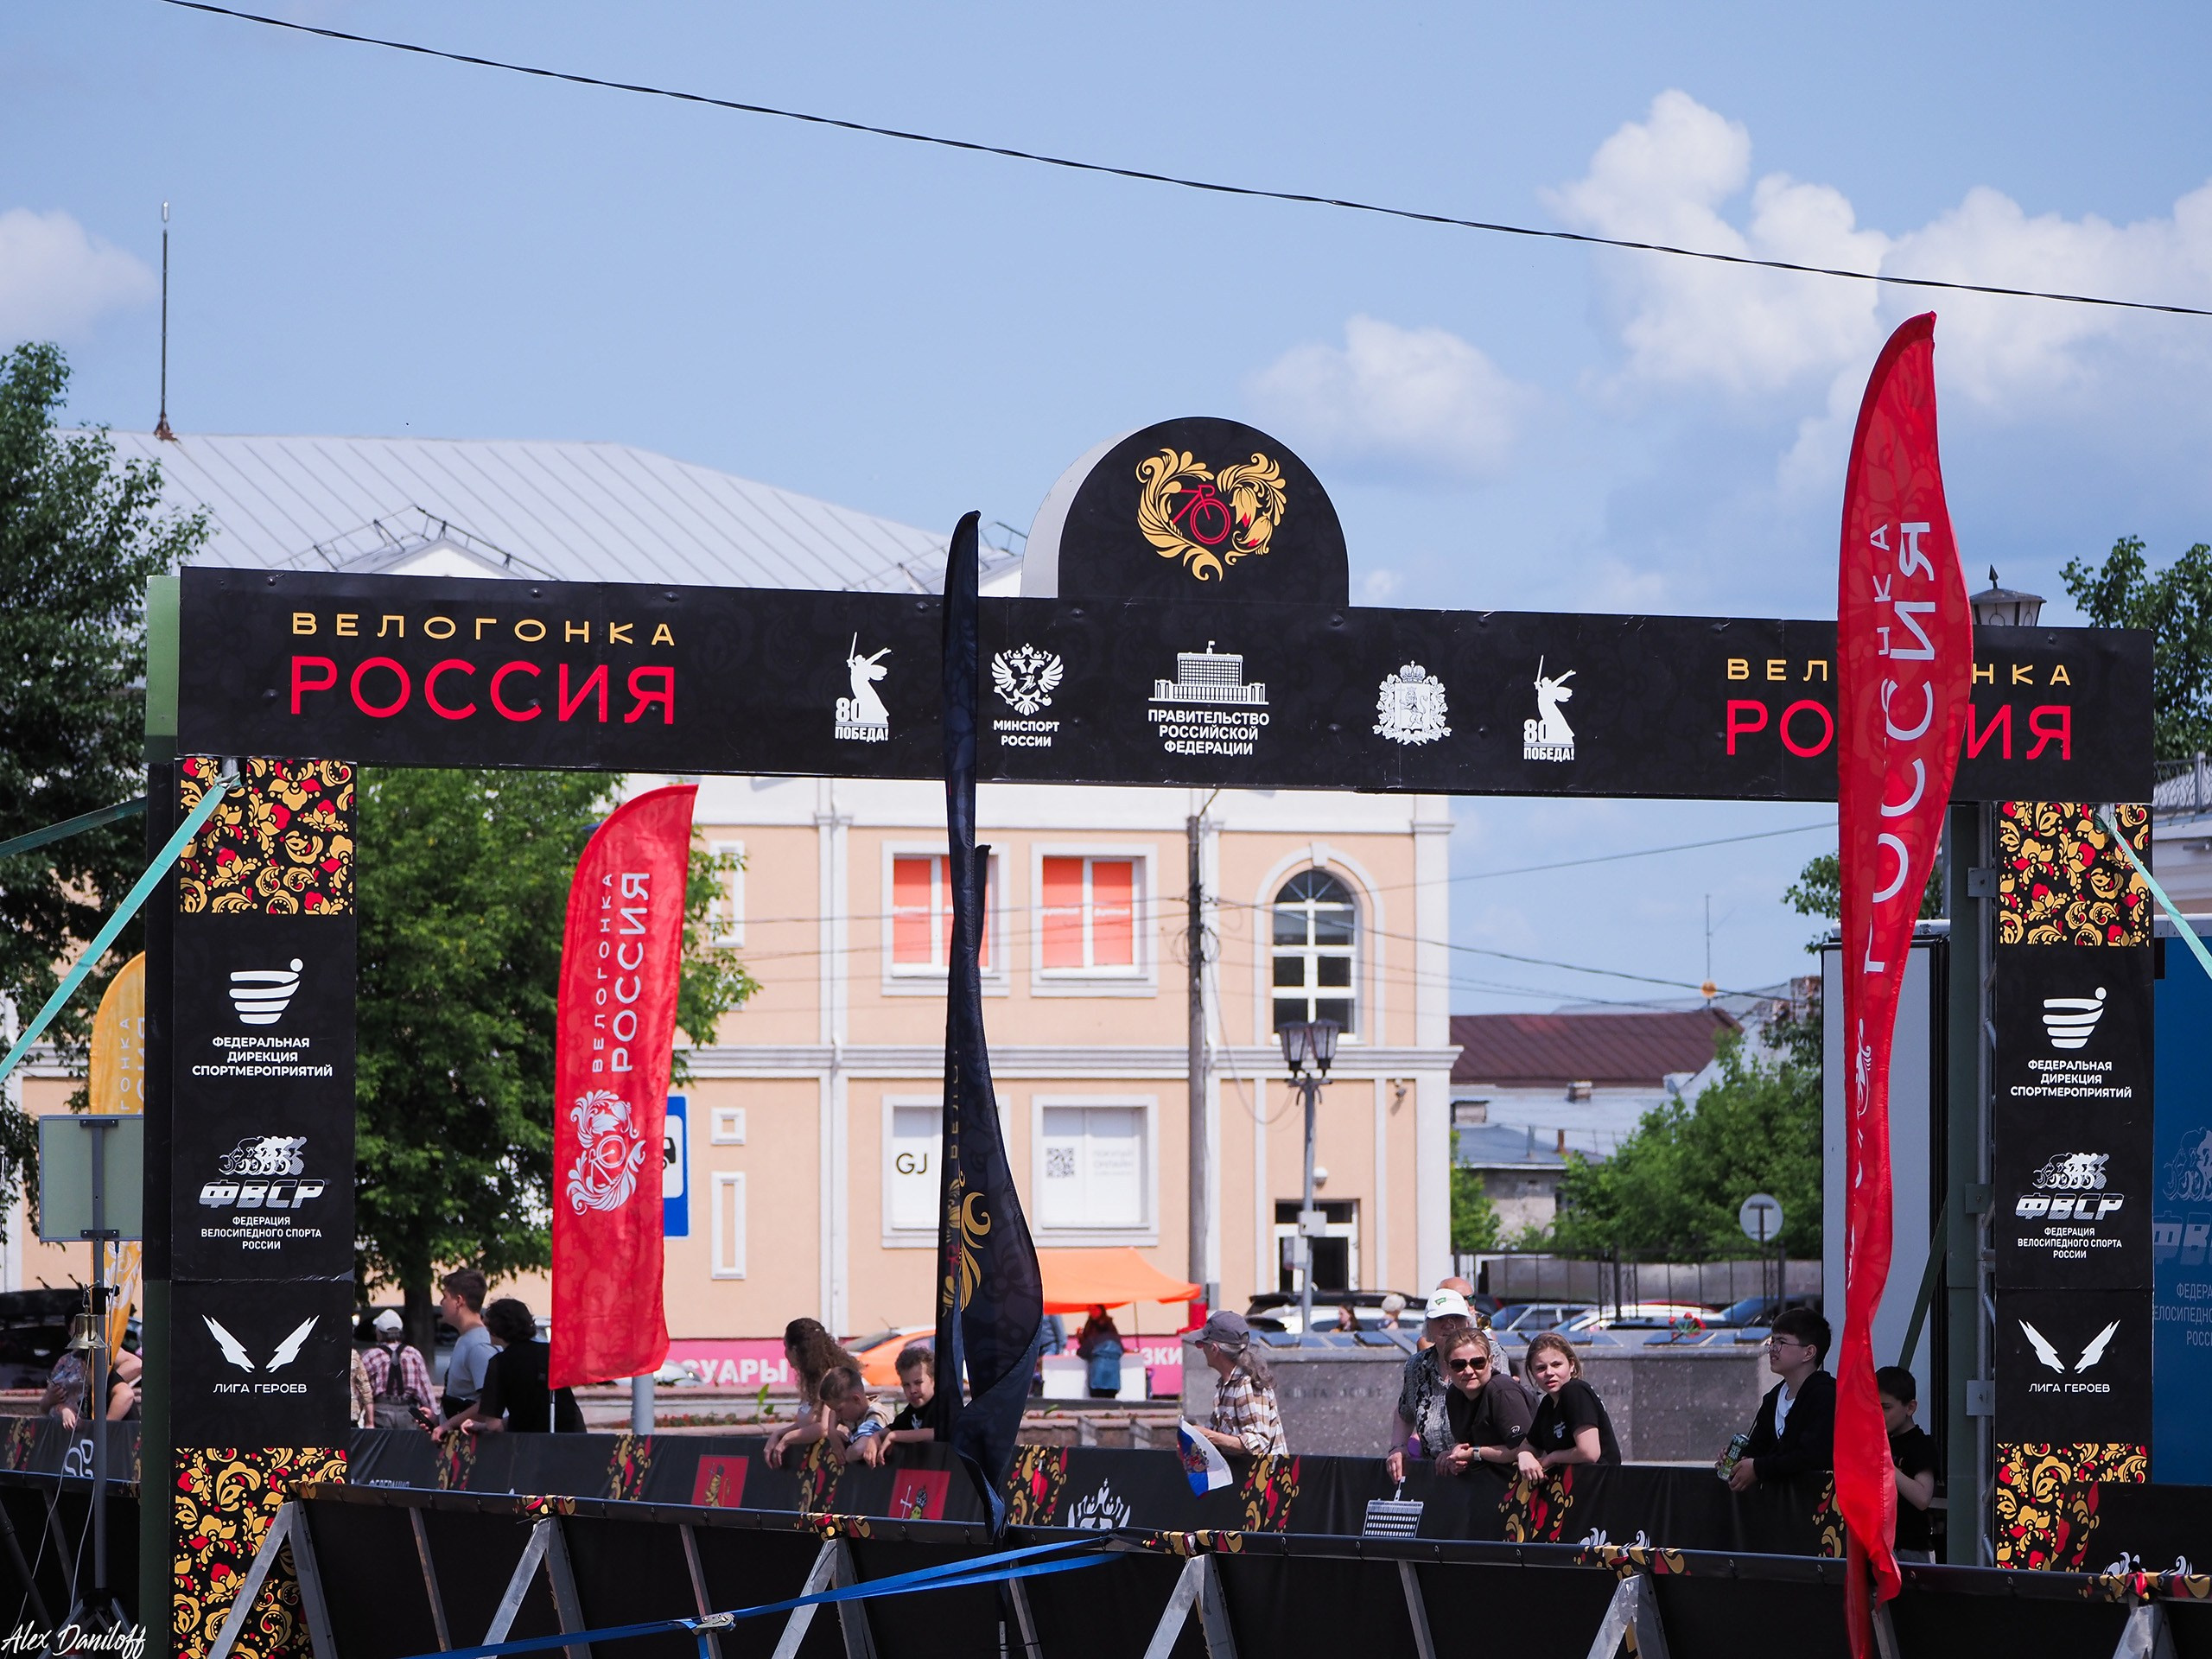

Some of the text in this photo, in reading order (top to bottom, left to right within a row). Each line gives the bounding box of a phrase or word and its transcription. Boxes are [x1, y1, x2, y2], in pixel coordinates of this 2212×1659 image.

[292, 612, 675, 646] ВЕЛОГОНКА
[1727, 658, 2071, 686] ВЕЛНКА
[291, 656, 675, 725] РОССИЯ
[836, 697, 863, 722] 80
[1147, 709, 1270, 727] ПРАВИТЕЛЬСТВО
[835, 726, 889, 743] ПОБЕДА!
[993, 720, 1060, 733] МИНСПОРТ
[1159, 723, 1259, 742] РОССИЙСКОЙ
[1523, 719, 1550, 743] 80
[1726, 699, 2071, 760] РОИЯ
[1001, 734, 1052, 747] РОССИИ
[1164, 741, 1253, 757] ФЕДЕРАЦИИ
[1523, 747, 1575, 763] ПОБЕДА!
[592, 873, 613, 1074] ВЕЛОГОНКА
[611, 872, 651, 1073] РОССИЯ
[212, 1036, 310, 1049] ФЕДЕРАЛЬНАЯ
[118, 1017, 130, 1110] ГОНКА
[226, 1051, 298, 1064] ДИРЕКЦИЯ
[2027, 1059, 2113, 1072] ФЕДЕРАЛЬНАЯ
[192, 1064, 333, 1077] СПОРТМЕРОПРИЯТИЙ
[2040, 1073, 2102, 1086] ДИРЕКЦИЯ
[2010, 1085, 2132, 1098] СПОРТМЕРОПРИЯТИЙ
[895, 1152, 929, 1175] GJ
[199, 1179, 326, 1209] ФВСР
[2015, 1192, 2125, 1220] ФВСР
[232, 1216, 291, 1227] ФЕДЕРАЦИЯ
[200, 1228, 322, 1239] ВЕЛОСИПЕДНОГО СПОРТА
[2044, 1226, 2095, 1236] ФЕДЕРАЦИЯ
[2153, 1211, 2212, 1265] ФВ
[242, 1240, 281, 1250] РОССИИ
[2018, 1238, 2122, 1249] ВЕЛОСИПЕДНОГО СПОРТА
[2053, 1249, 2087, 1259] РОССИИ
[213, 1383, 308, 1394] ЛИГА ГЕРОЕВ
[2028, 1382, 2111, 1394] ЛИГА ГЕРОЕВ
